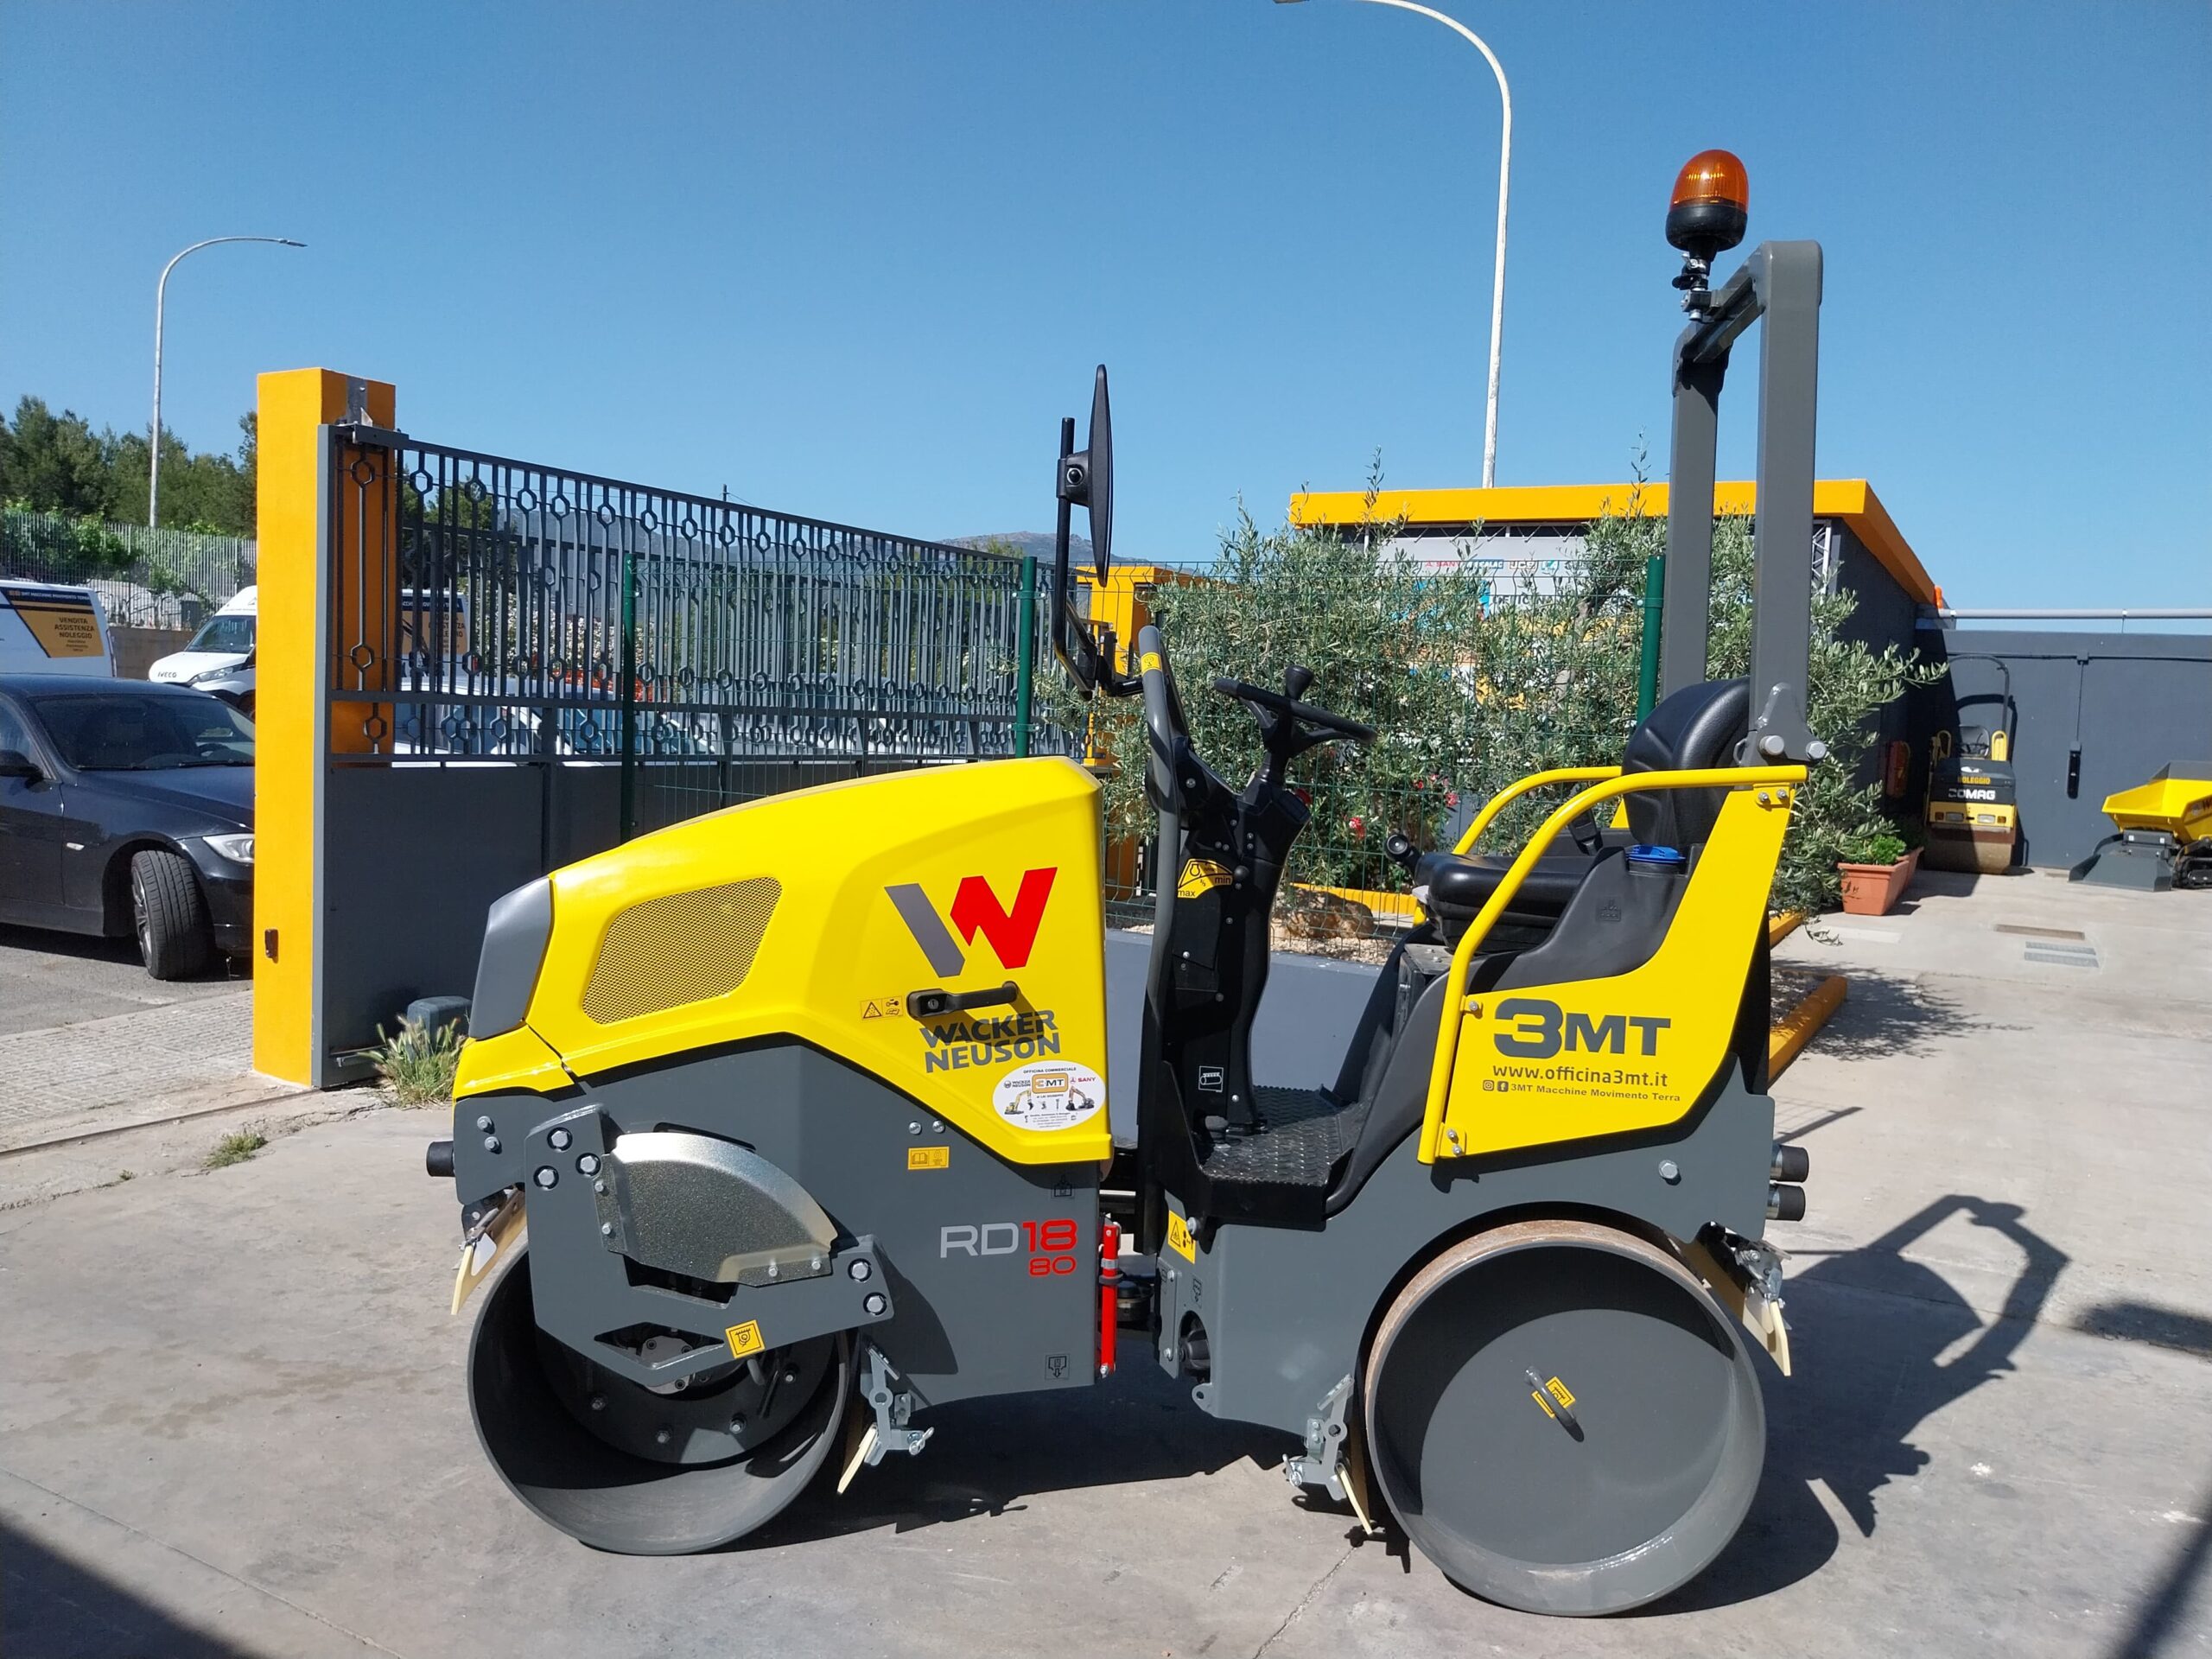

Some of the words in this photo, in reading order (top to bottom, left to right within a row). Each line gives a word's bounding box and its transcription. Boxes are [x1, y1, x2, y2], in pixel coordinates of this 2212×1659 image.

[54, 624, 95, 632] ASSISTENZA
[58, 616, 89, 625] VENDITA
[1214, 875, 1231, 884] min
[919, 1009, 1059, 1048] WACKER
[1493, 997, 1671, 1059] 3MT
[925, 1033, 1061, 1073] NEUSON
[1492, 1065, 1669, 1088] www.officina3mt.it
[1510, 1084, 1533, 1093] 3MT
[1536, 1085, 1588, 1096] Macchine
[1590, 1088, 1649, 1101] Movimento
[1651, 1092, 1681, 1102] Terra
[940, 1218, 1078, 1259] RD18
[1028, 1255, 1077, 1277] 80
